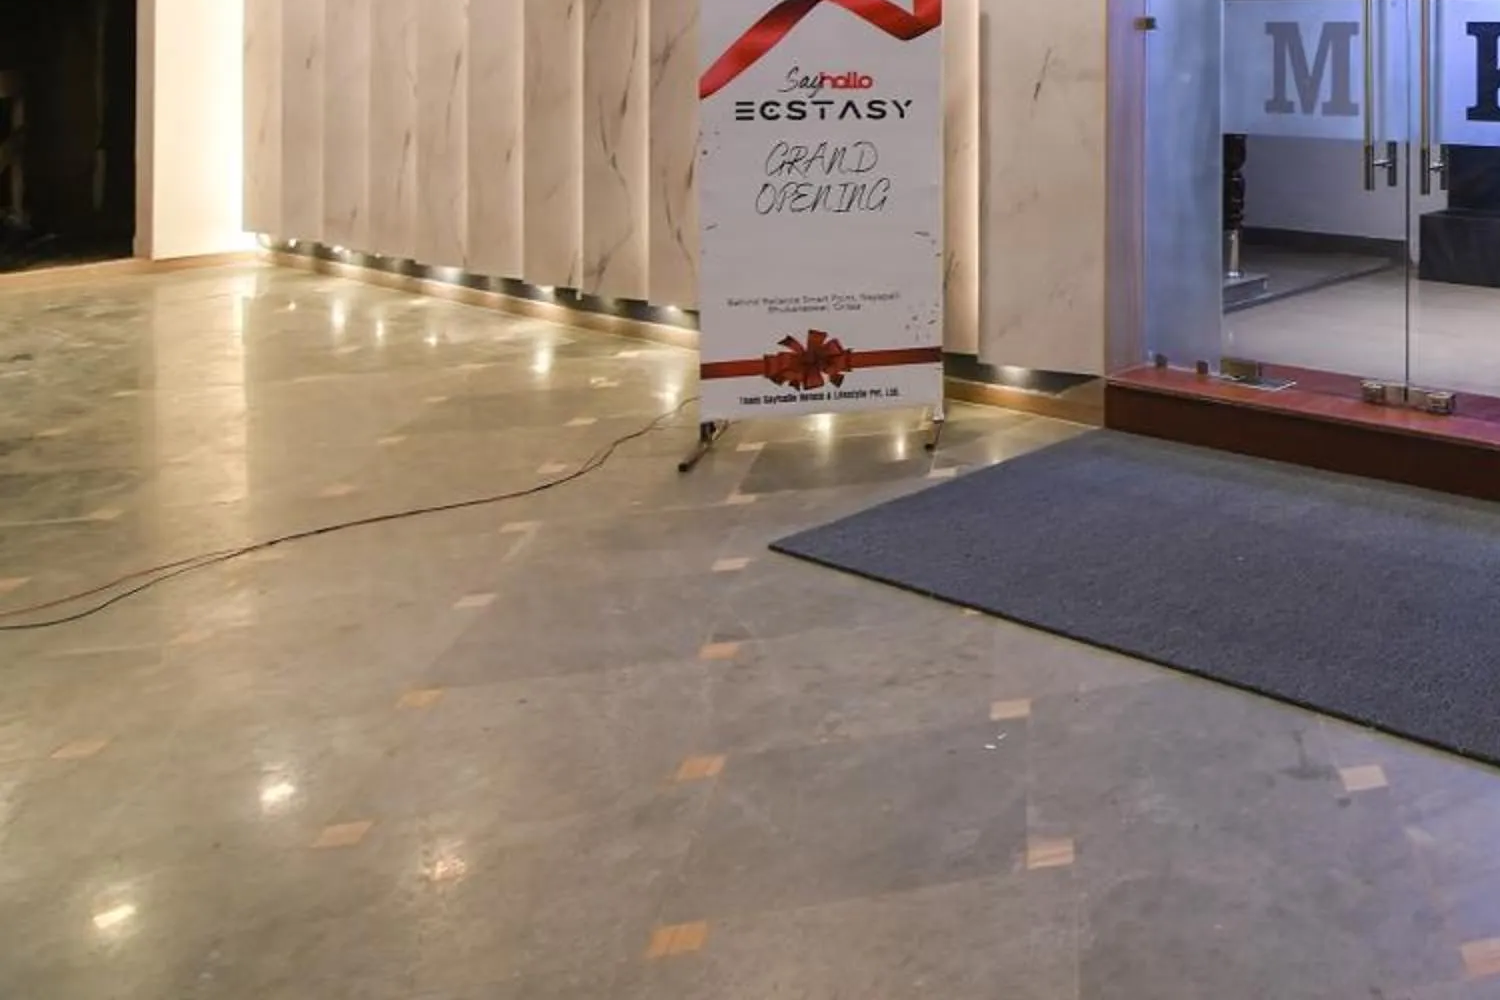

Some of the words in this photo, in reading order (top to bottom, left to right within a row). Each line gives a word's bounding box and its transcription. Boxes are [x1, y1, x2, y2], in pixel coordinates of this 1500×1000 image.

[1264, 22, 1359, 116] M
[735, 100, 912, 121] ECSTASY
[765, 141, 878, 178] GRAND
[755, 177, 890, 215] OPENING
